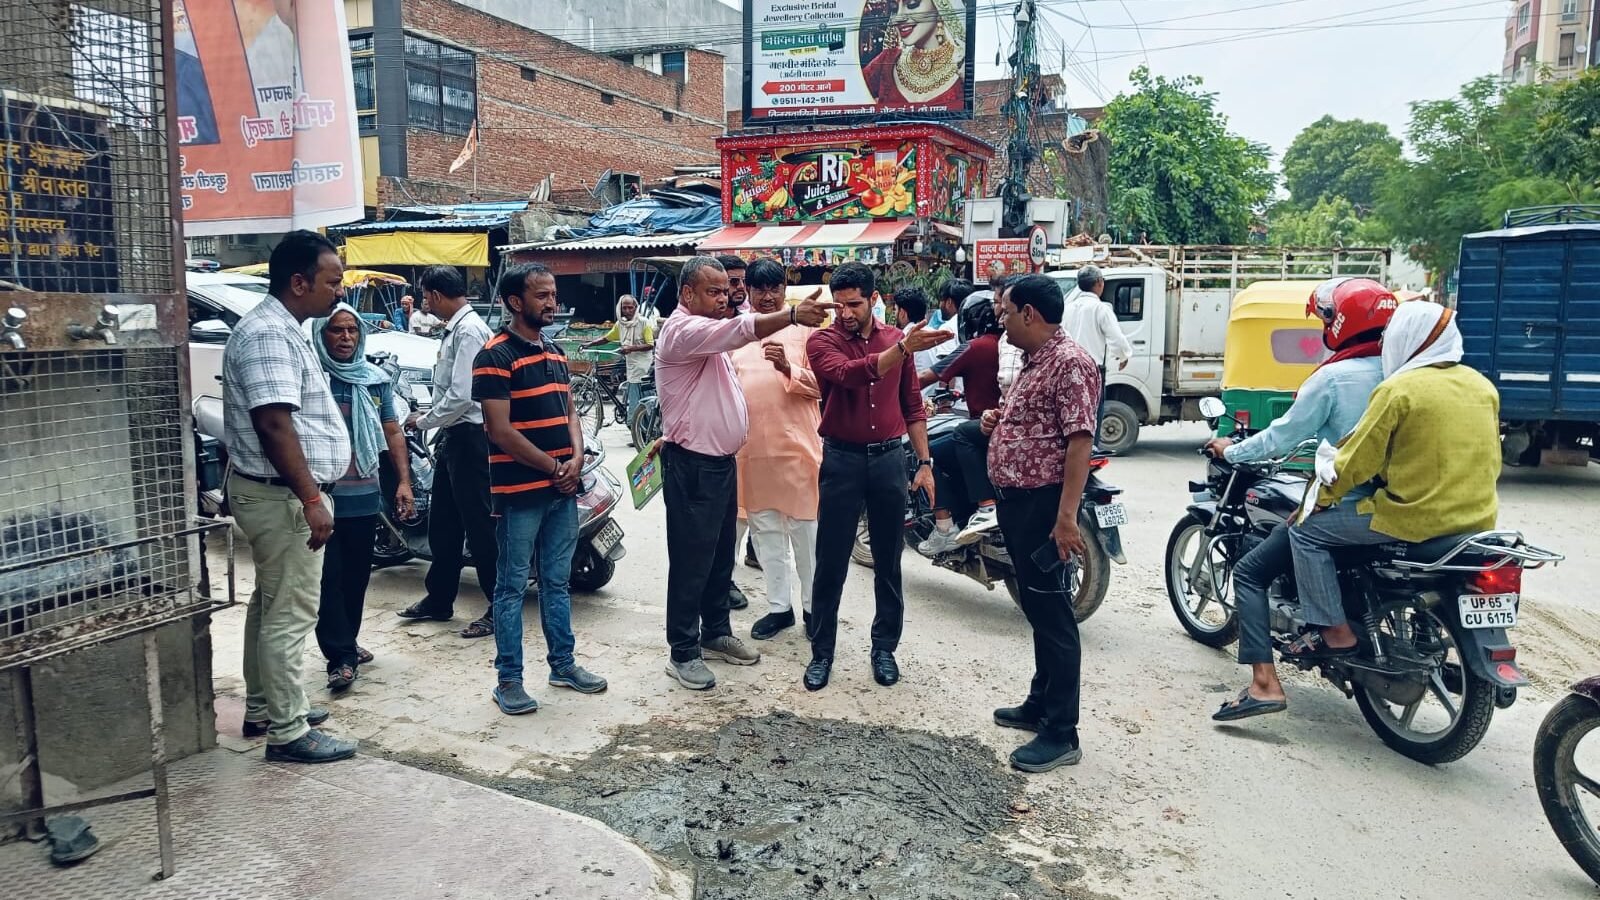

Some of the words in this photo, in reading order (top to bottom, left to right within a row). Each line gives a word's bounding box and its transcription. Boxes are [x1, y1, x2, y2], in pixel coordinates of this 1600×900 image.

[771, 4, 809, 12] Exclusive
[811, 2, 836, 10] Bridal
[804, 12, 844, 20] Collection
[735, 165, 752, 177] Mix
[821, 153, 844, 187] Rj
[741, 183, 768, 203] Juice
[804, 184, 830, 199] Juice
[826, 190, 849, 205] Shakes
[1035, 234, 1043, 245] Go
[1331, 312, 1346, 339] ACC
[1470, 597, 1486, 609] UP
[1488, 597, 1502, 608] 65
[1465, 613, 1482, 625] CU
[1487, 612, 1514, 624] 6175
